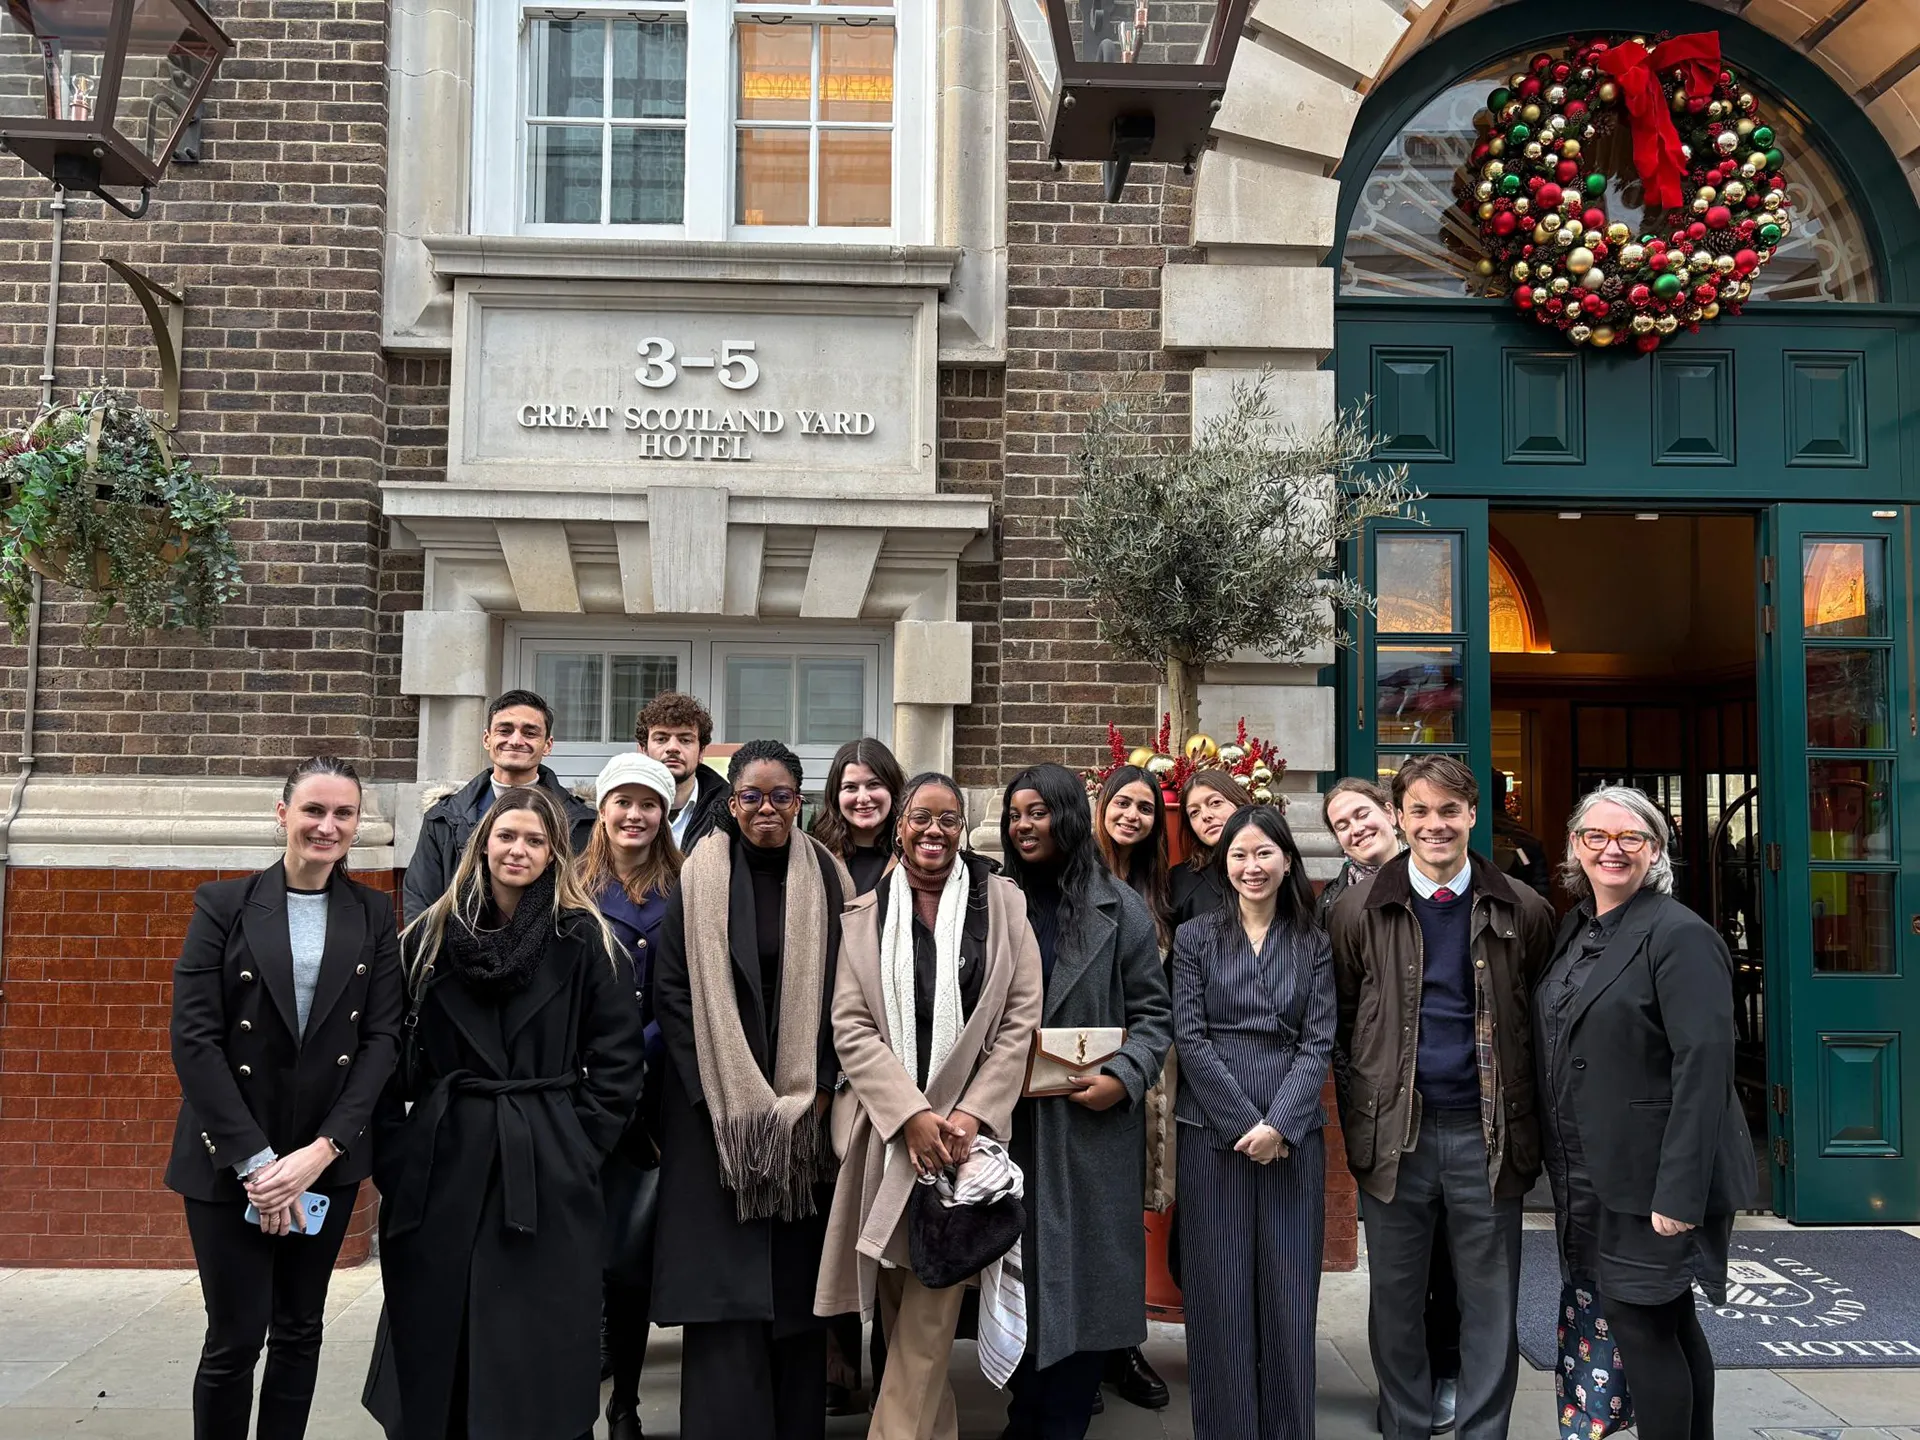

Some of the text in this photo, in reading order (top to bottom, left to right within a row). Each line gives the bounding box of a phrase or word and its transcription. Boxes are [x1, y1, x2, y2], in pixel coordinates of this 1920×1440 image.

[517, 404, 876, 436] GREAT SCOTLAND YARD
[639, 434, 752, 460] HOTEL
[1695, 1258, 1866, 1328] COTLAND YARD
